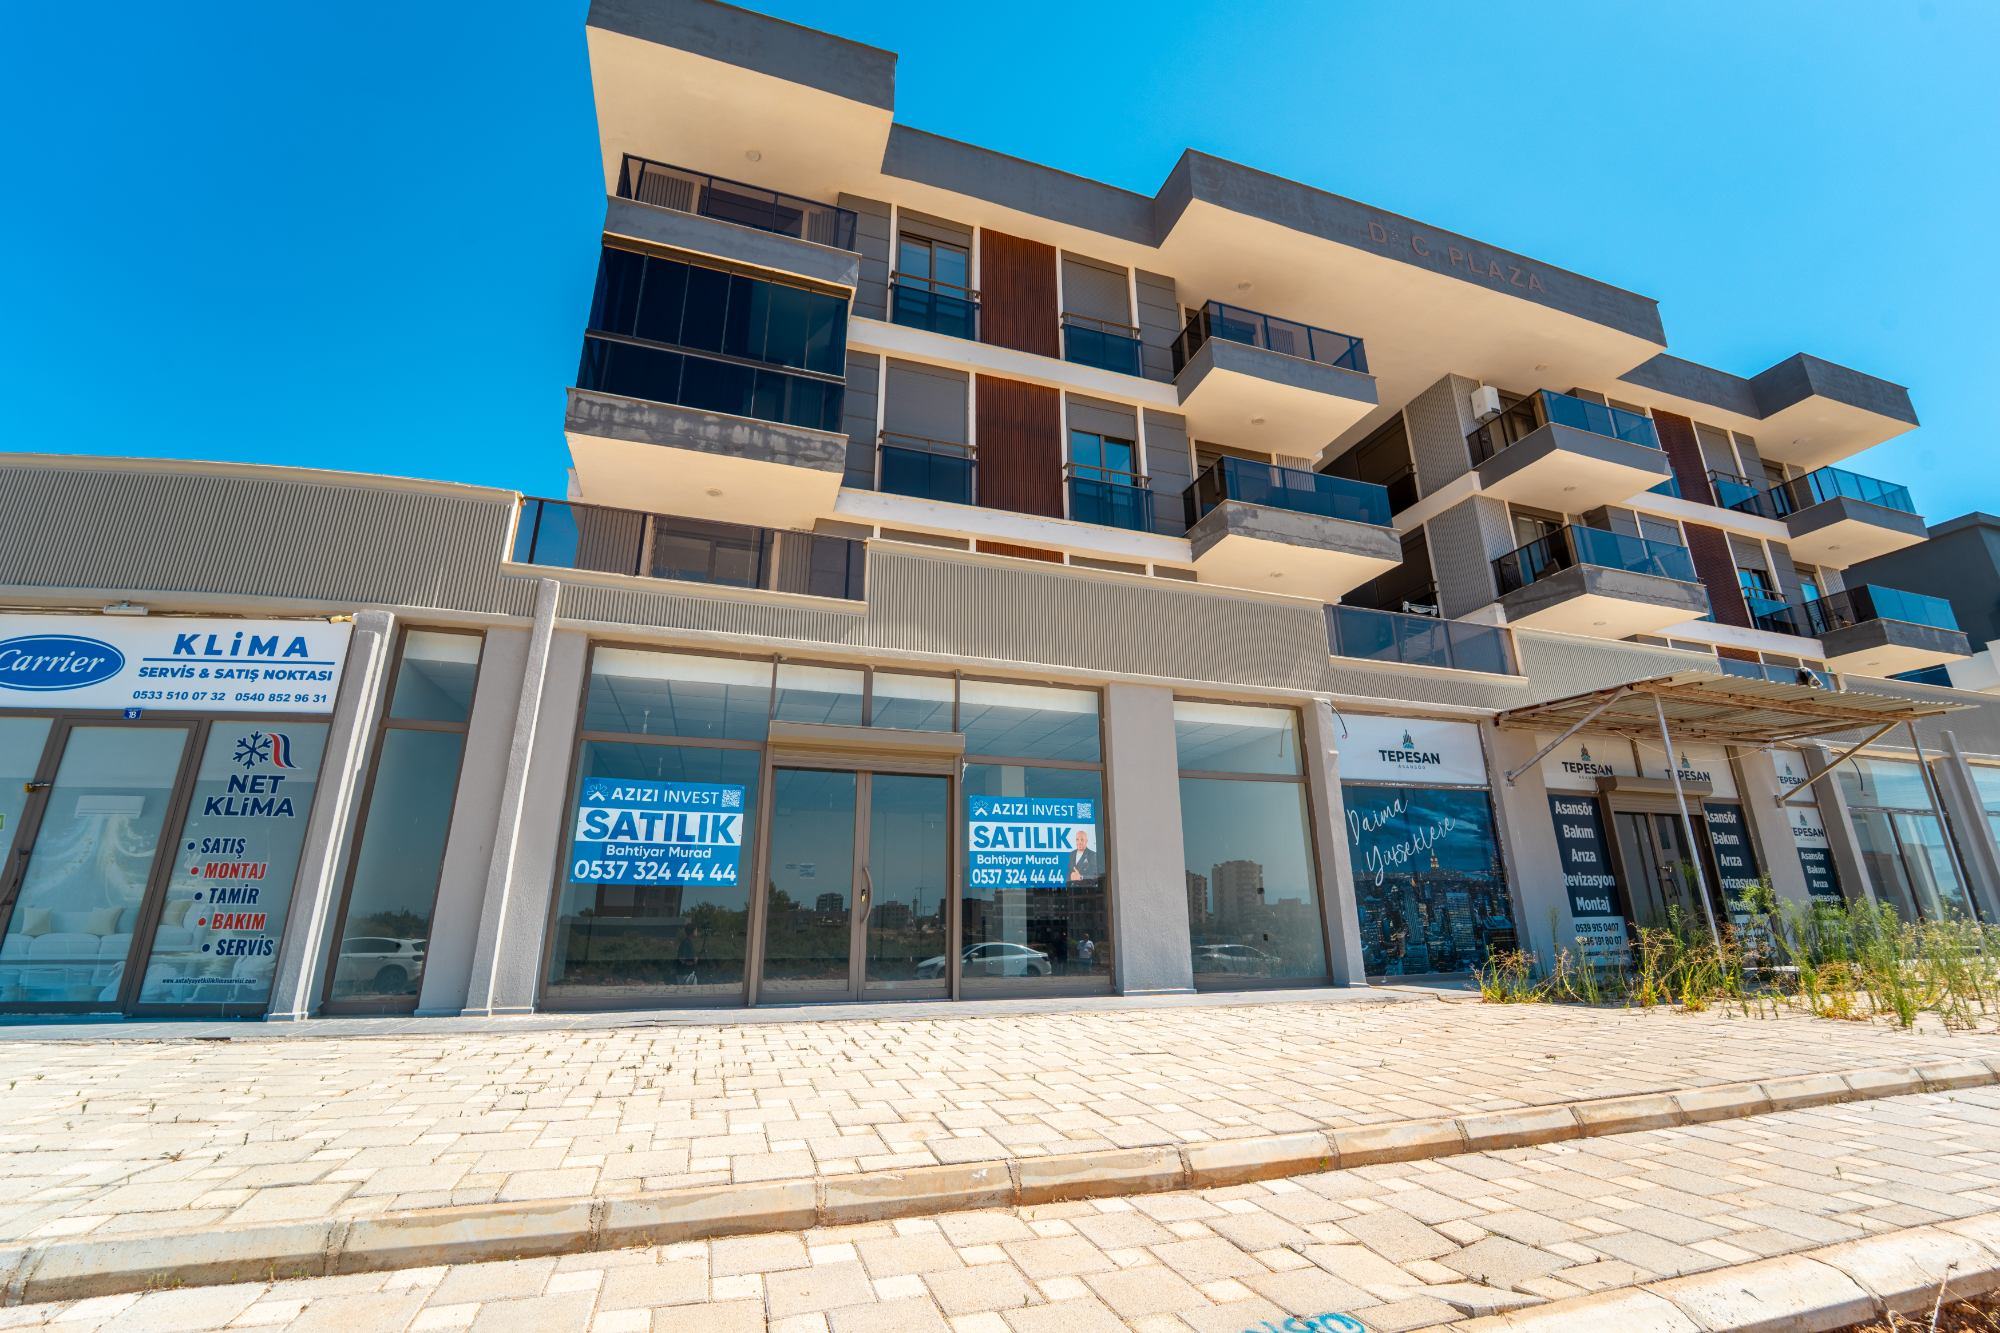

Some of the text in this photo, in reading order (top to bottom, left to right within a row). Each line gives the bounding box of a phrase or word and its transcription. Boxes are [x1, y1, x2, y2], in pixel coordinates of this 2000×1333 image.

[1367, 221, 1387, 244] D
[1410, 233, 1429, 257] C
[1448, 247, 1546, 294] PLAZA
[0, 649, 105, 673] Carrier
[138, 664, 333, 682] SERVİS & SATIŞ NOKTASI
[132, 690, 327, 703] 0533 510 07 32 0540 852 96 31
[1378, 749, 1441, 765] TEPESAN
[1562, 762, 1613, 776] TEPESAN
[1665, 769, 1711, 782] TPESAN
[227, 774, 286, 794] NET
[611, 787, 720, 805] AZIZI INVEST
[992, 803, 1075, 817] AZIZI INVEST
[1555, 800, 1593, 816] Asansör
[583, 809, 737, 844] SATILIK
[1346, 798, 1408, 846] Daima
[973, 825, 1073, 849] SATILIK
[1562, 824, 1595, 839] Bakım
[1712, 831, 1740, 845] Bakım
[201, 837, 246, 859] SATIŞ
[606, 845, 712, 859] Bahtiyar Murad
[1571, 848, 1596, 863] Arıza
[977, 854, 1059, 867] Bahtiyar Murad
[1720, 853, 1743, 867] Arıza
[204, 862, 267, 880] MONTAJ
[574, 859, 737, 882] 0537 324 44 44
[972, 869, 1064, 884] 0537 324 44 44
[209, 884, 260, 905] TAMİR
[1576, 896, 1611, 913] Montaj
[211, 913, 266, 930] BAKIM
[1575, 923, 1591, 933] 0539
[1592, 923, 1603, 932] 915
[216, 935, 274, 956] SERVİS
